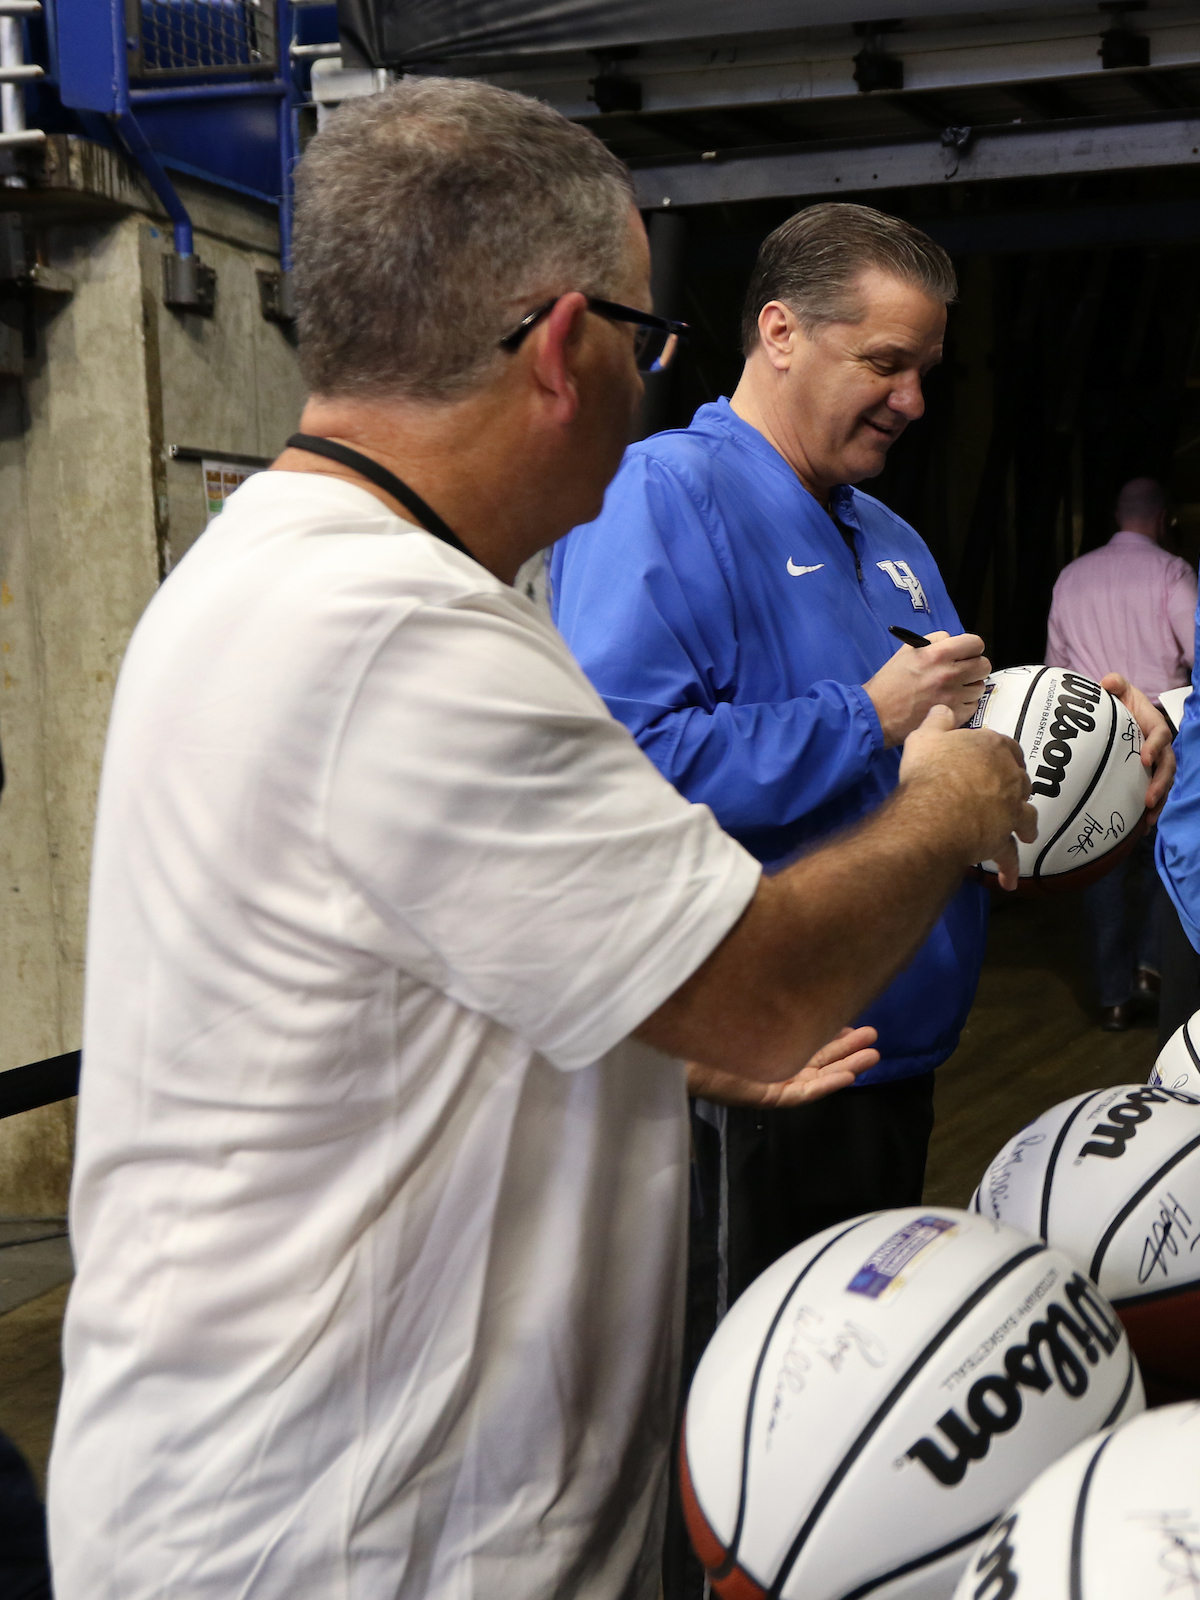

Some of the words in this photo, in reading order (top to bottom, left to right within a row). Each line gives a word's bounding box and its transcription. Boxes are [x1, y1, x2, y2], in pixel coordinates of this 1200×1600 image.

[1029, 712, 1049, 760] BASKETBALL
[1032, 673, 1102, 798] Wilson
[1044, 678, 1057, 712] AUTOGRAPH
[905, 1272, 1125, 1486] Wilson
